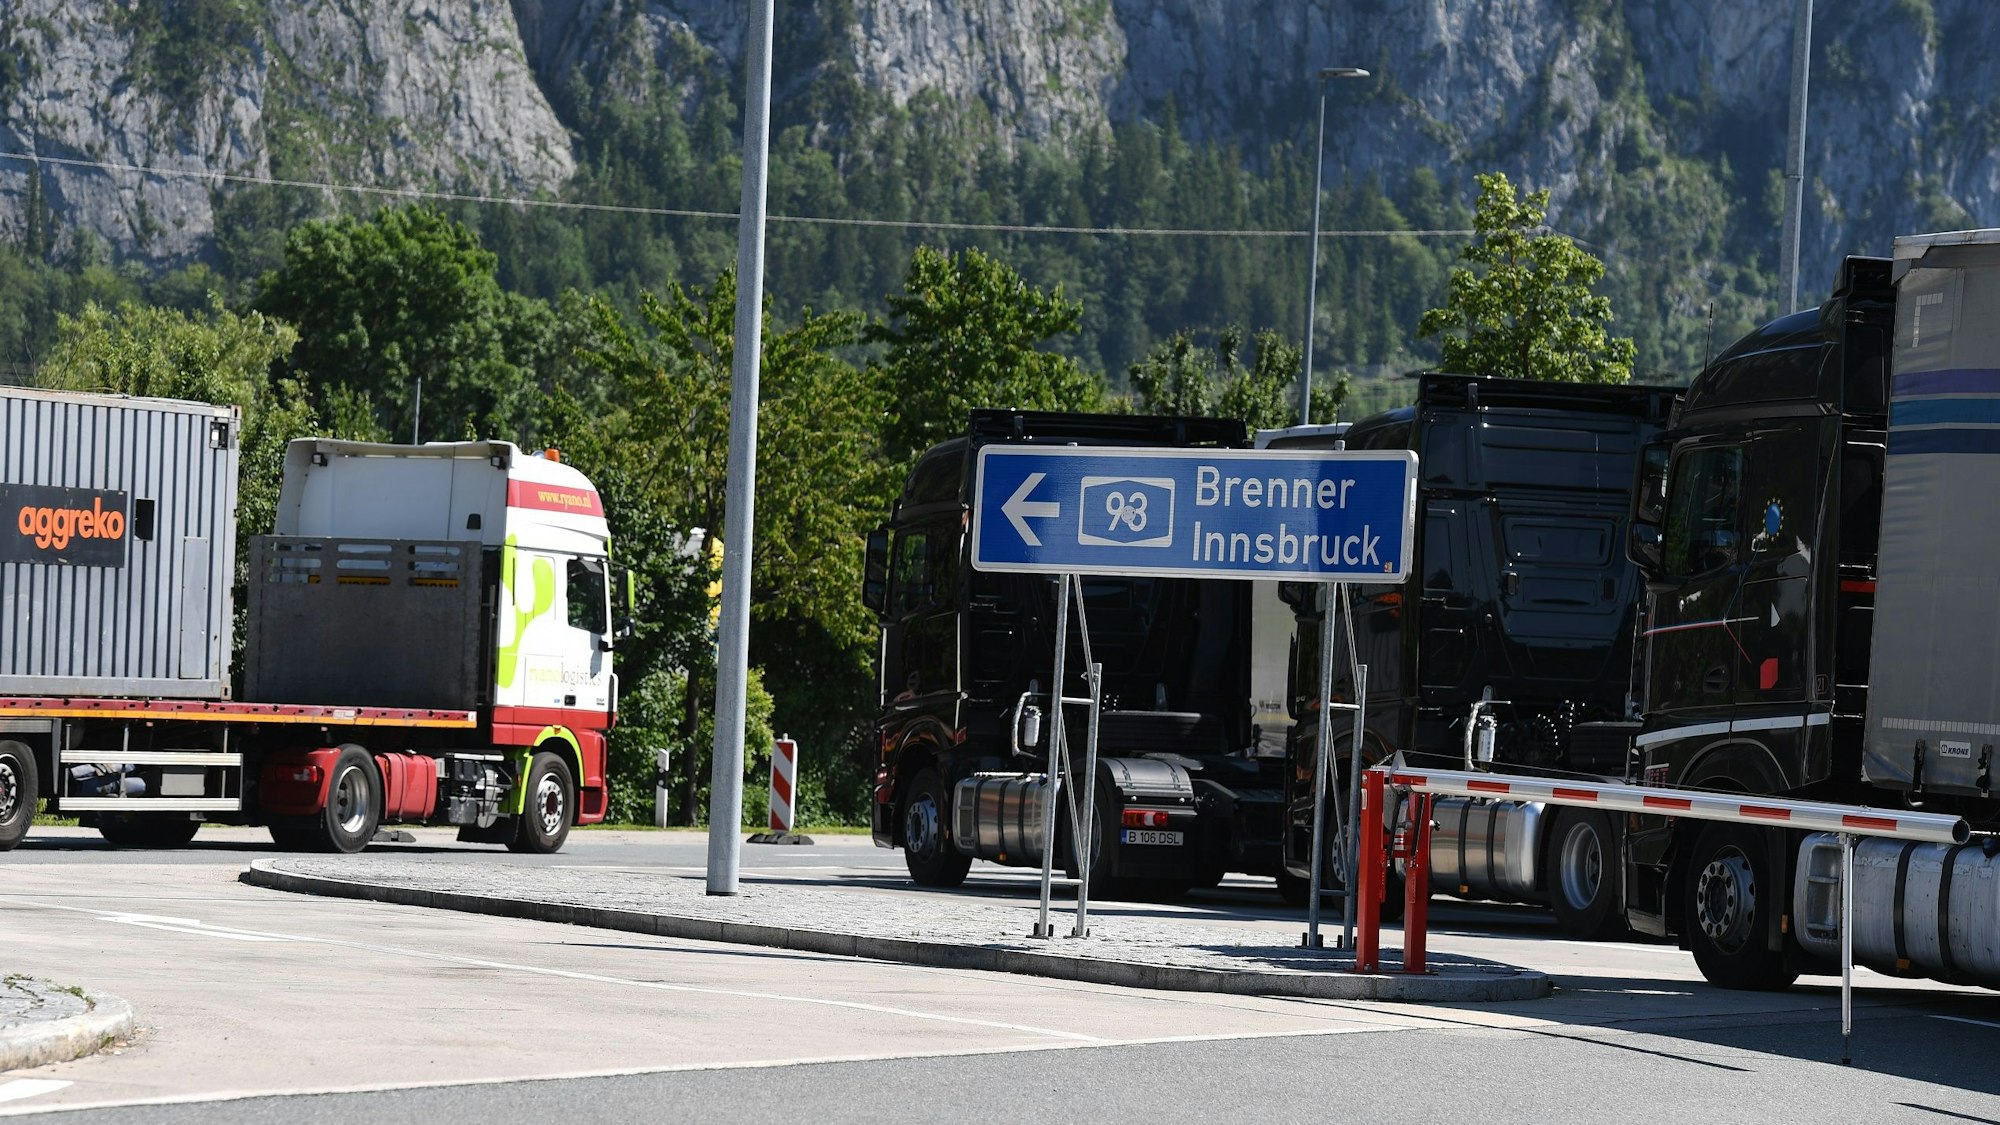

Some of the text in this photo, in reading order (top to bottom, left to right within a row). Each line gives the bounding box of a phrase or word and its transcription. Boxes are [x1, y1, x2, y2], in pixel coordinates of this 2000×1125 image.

[1195, 466, 1356, 509] Brenner
[18, 496, 125, 550] aggreko
[1106, 491, 1148, 532] 93
[1192, 521, 1381, 566] Innsbruck
[1947, 747, 1969, 756] KRONE
[1129, 831, 1137, 843] B
[1140, 832, 1156, 843] 106
[1159, 833, 1180, 845] DSL
